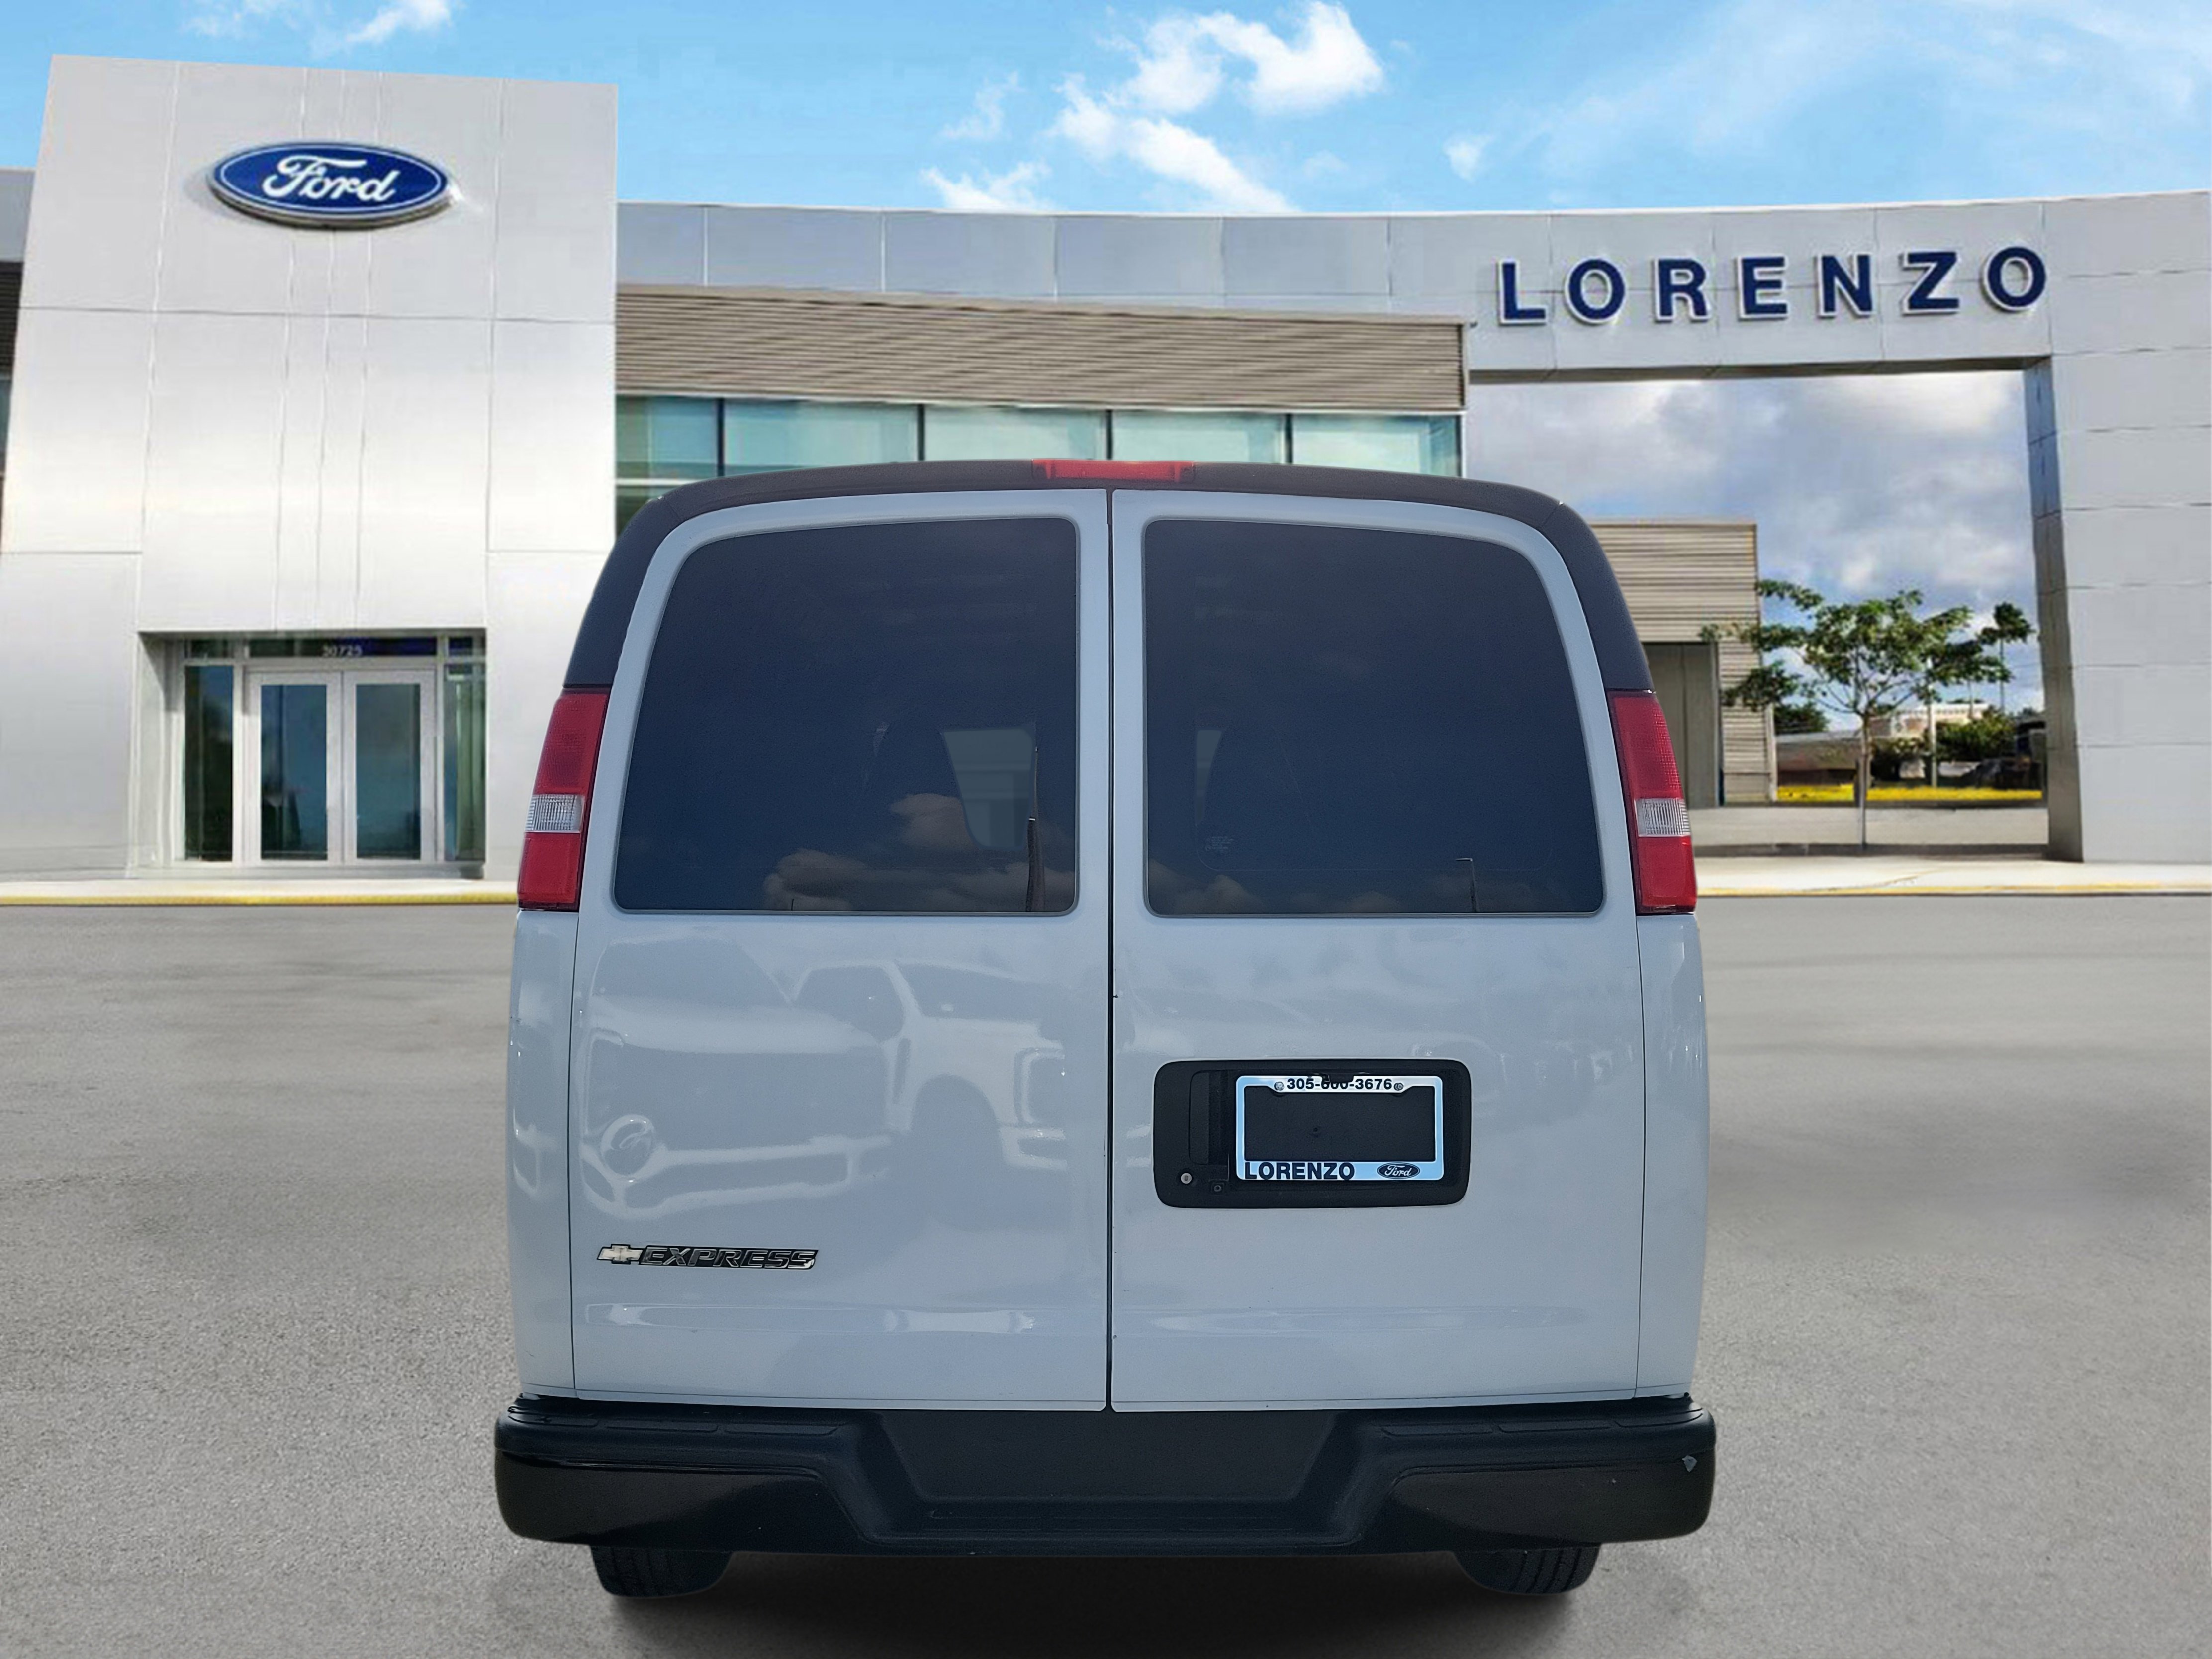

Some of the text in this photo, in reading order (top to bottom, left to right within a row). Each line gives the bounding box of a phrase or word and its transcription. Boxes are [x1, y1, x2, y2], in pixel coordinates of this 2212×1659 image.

[262, 154, 400, 202] Ford
[1497, 245, 2048, 325] LORENZO
[1245, 1162, 1412, 1181] LORENZO Ford
[640, 1246, 817, 1269] EXPRESS
